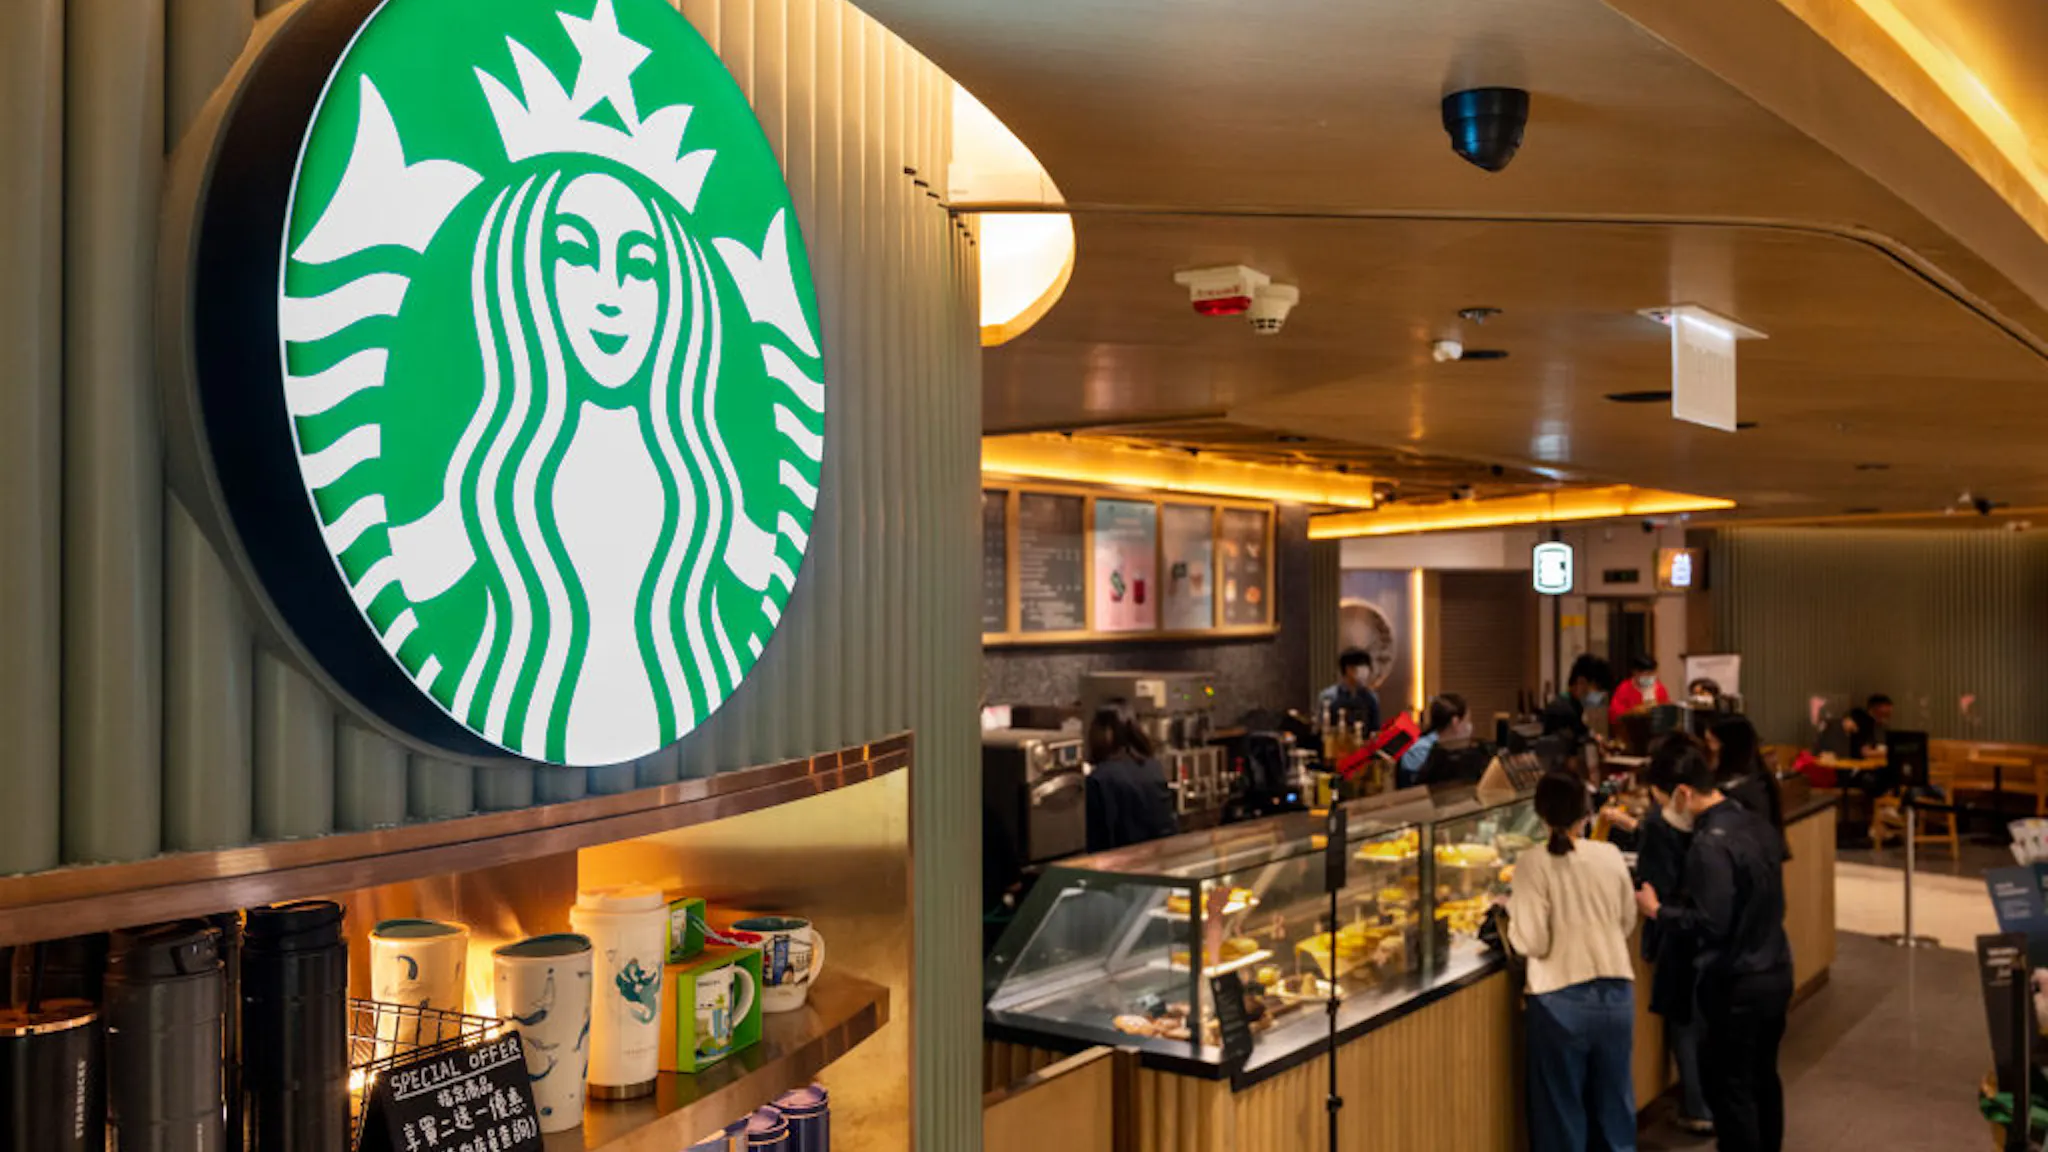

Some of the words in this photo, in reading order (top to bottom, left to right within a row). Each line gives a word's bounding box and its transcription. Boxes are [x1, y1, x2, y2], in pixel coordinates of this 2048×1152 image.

[75, 1059, 87, 1140] STARBUCKS
[391, 1058, 461, 1096] SPECIAL
[468, 1038, 522, 1069] OFFER
